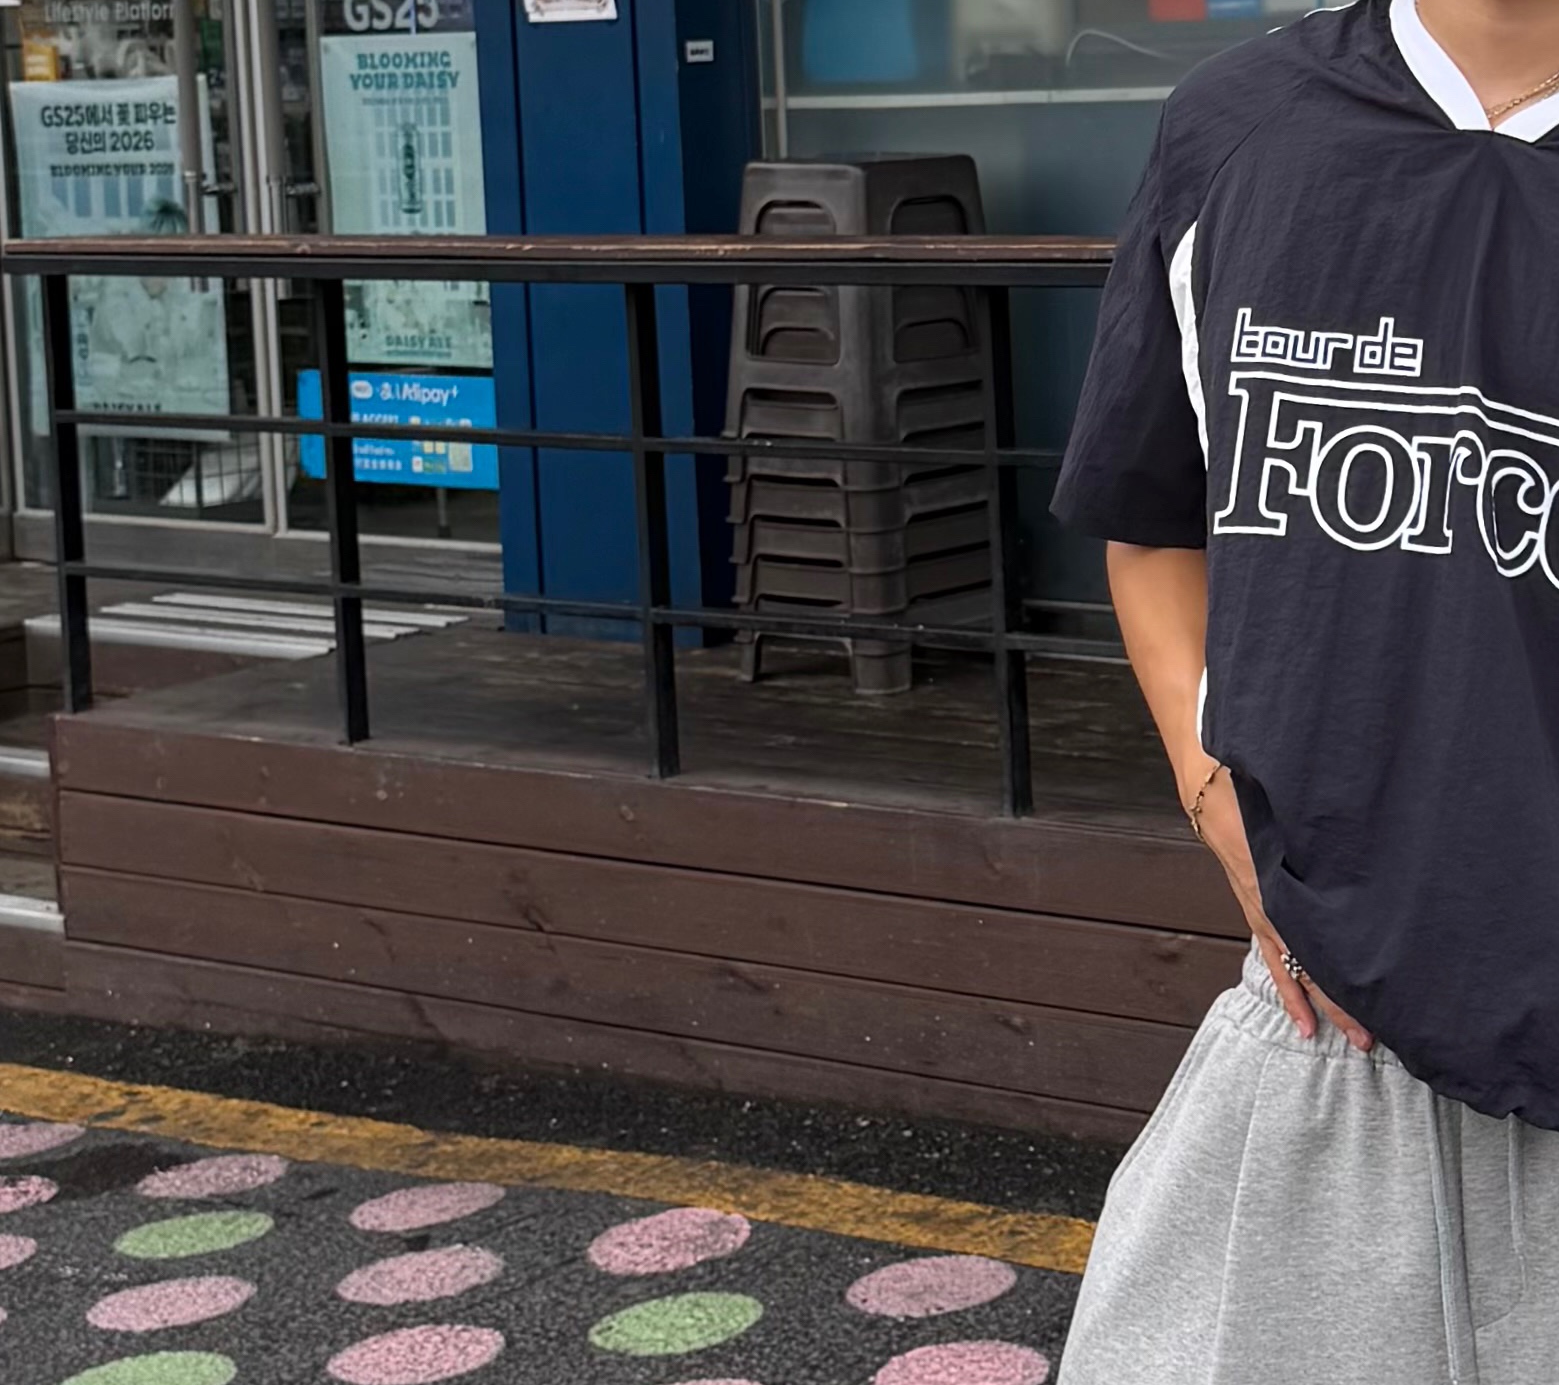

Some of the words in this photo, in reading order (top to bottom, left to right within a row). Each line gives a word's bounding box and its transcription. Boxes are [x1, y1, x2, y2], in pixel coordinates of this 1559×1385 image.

[357, 51, 452, 71] BLOOMING
[350, 72, 399, 91] YOUR
[402, 70, 460, 90] DAISY
[41, 102, 114, 129] GS25에서
[1353, 316, 1424, 378] de
